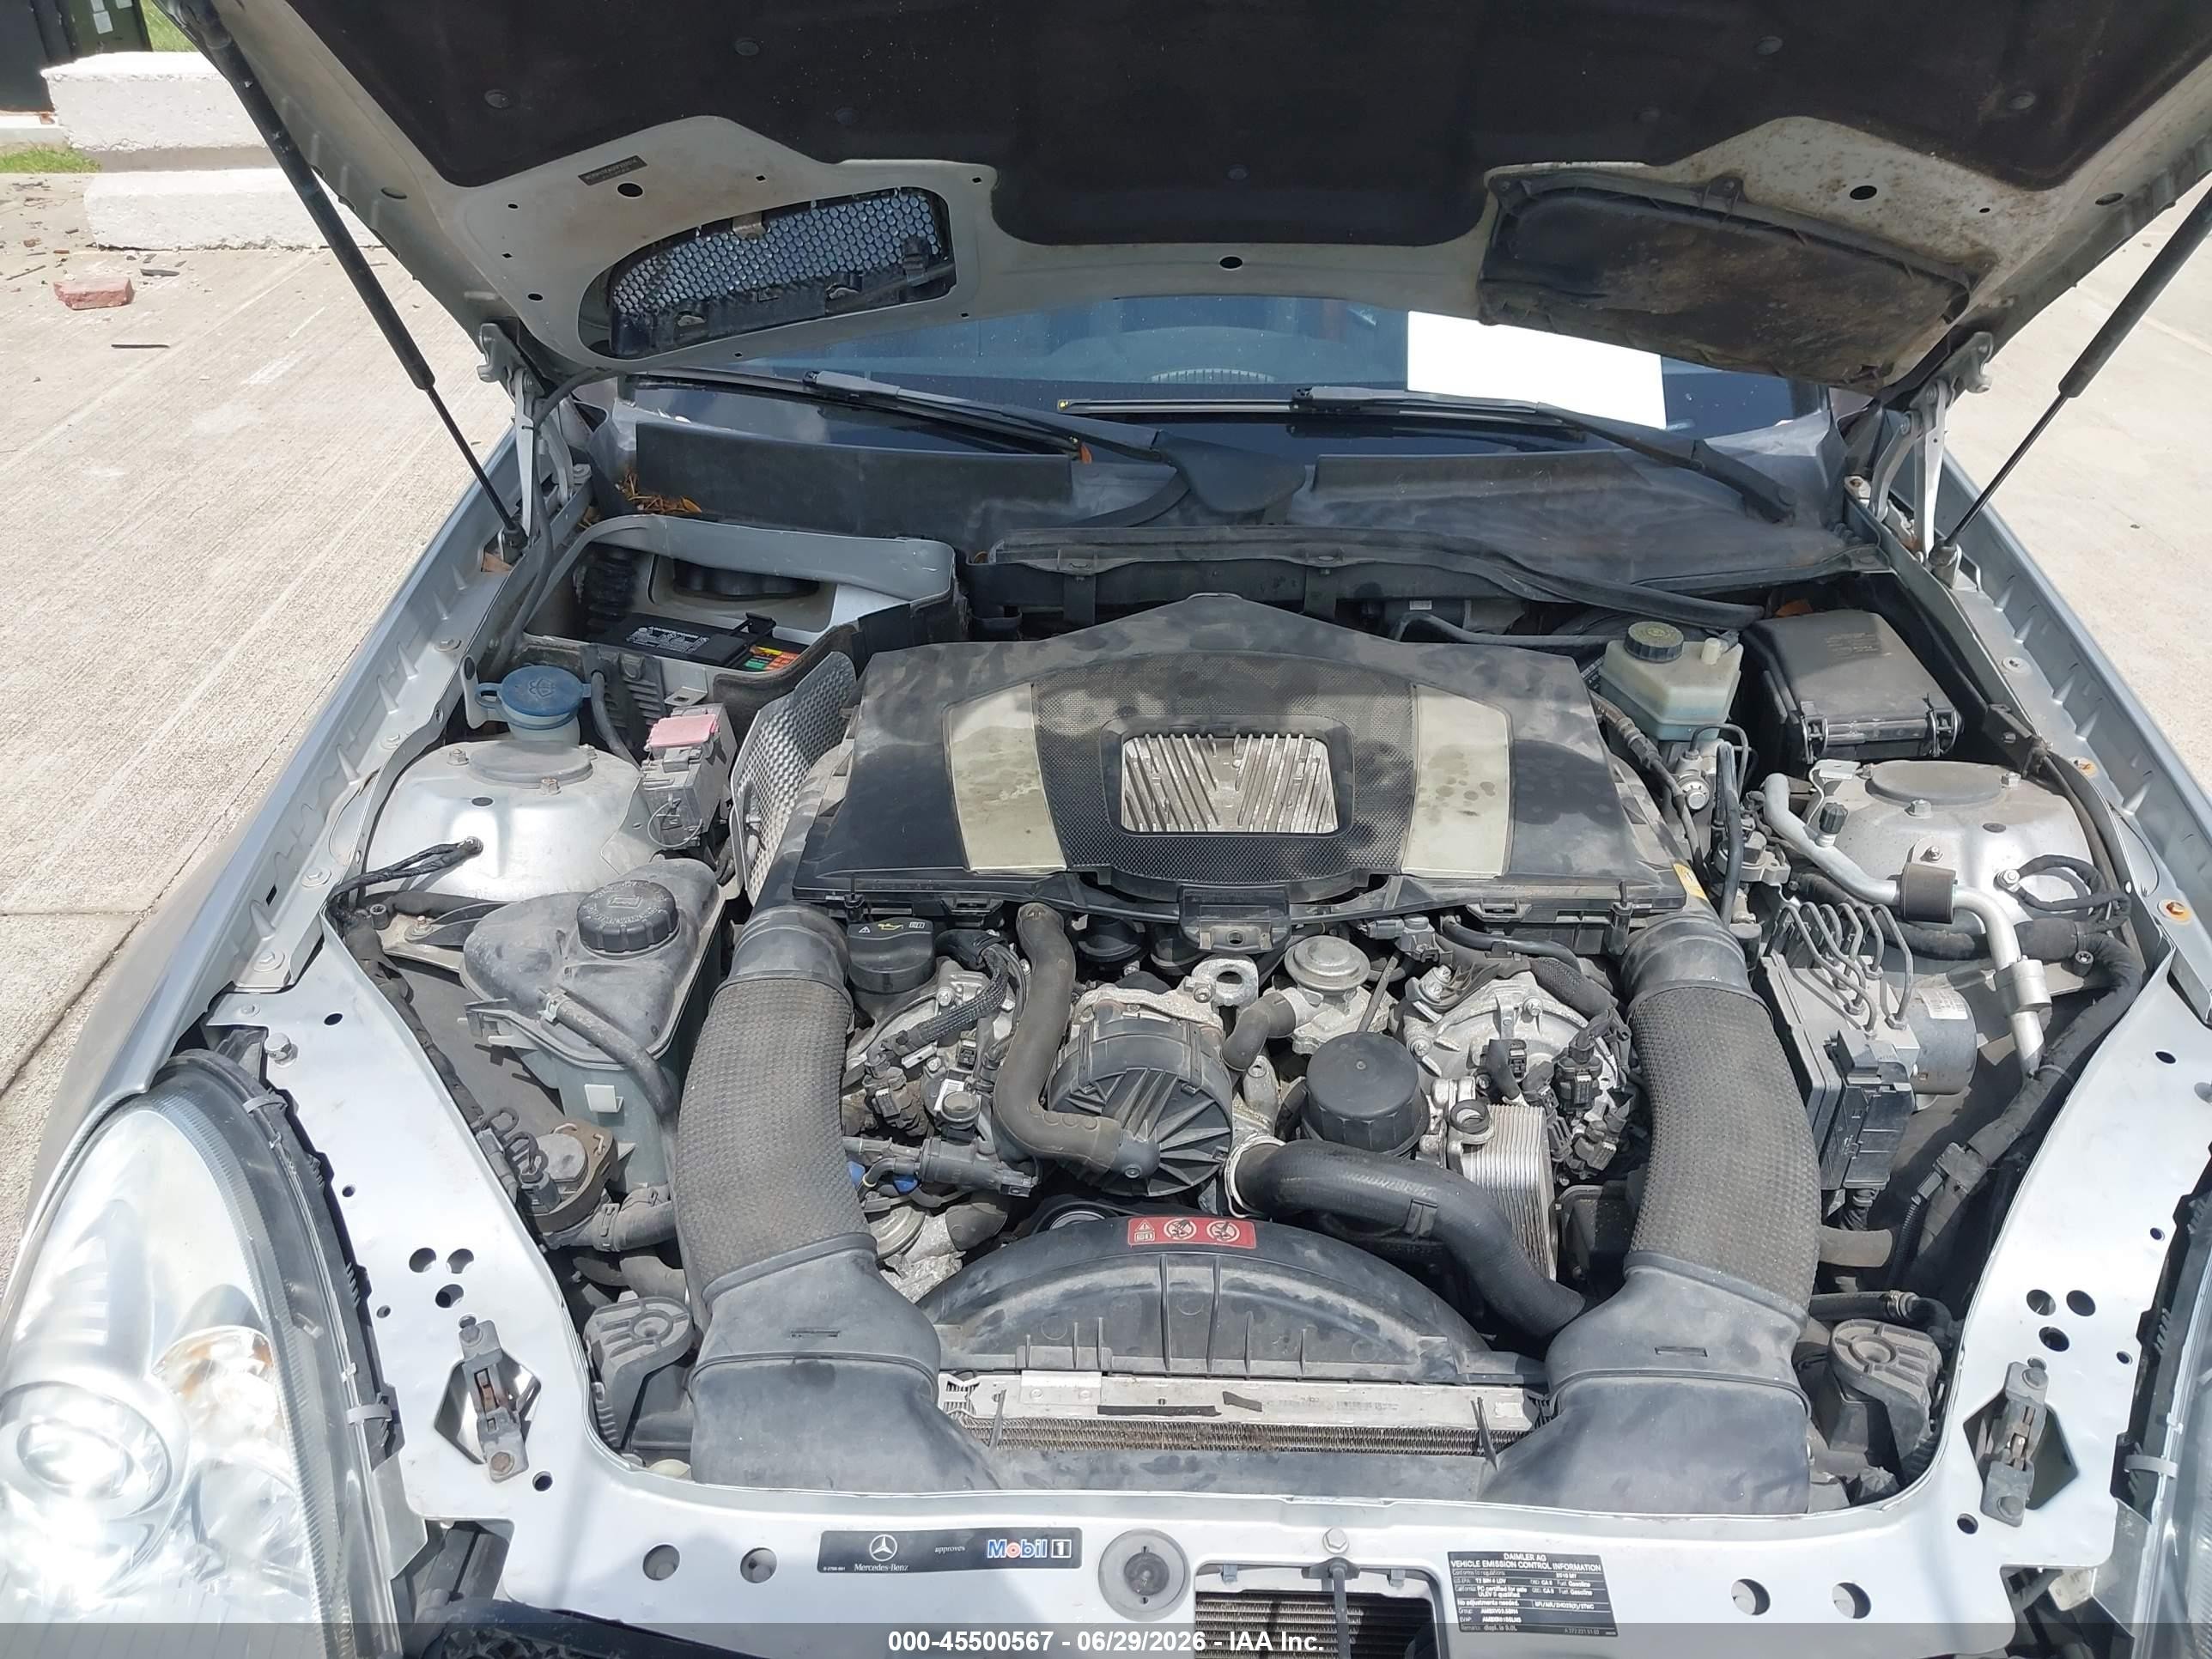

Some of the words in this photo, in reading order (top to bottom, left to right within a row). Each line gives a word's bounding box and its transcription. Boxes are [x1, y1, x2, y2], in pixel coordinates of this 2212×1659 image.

[987, 1539, 1048, 1559] Mobil
[1504, 1553, 1534, 1561] DAIMLER
[1451, 1559, 1481, 1568] VEHICLE
[1482, 1560, 1516, 1569] EMISSION
[1518, 1561, 1552, 1571] CONTROL
[1553, 1563, 1601, 1572] INFORMATION
